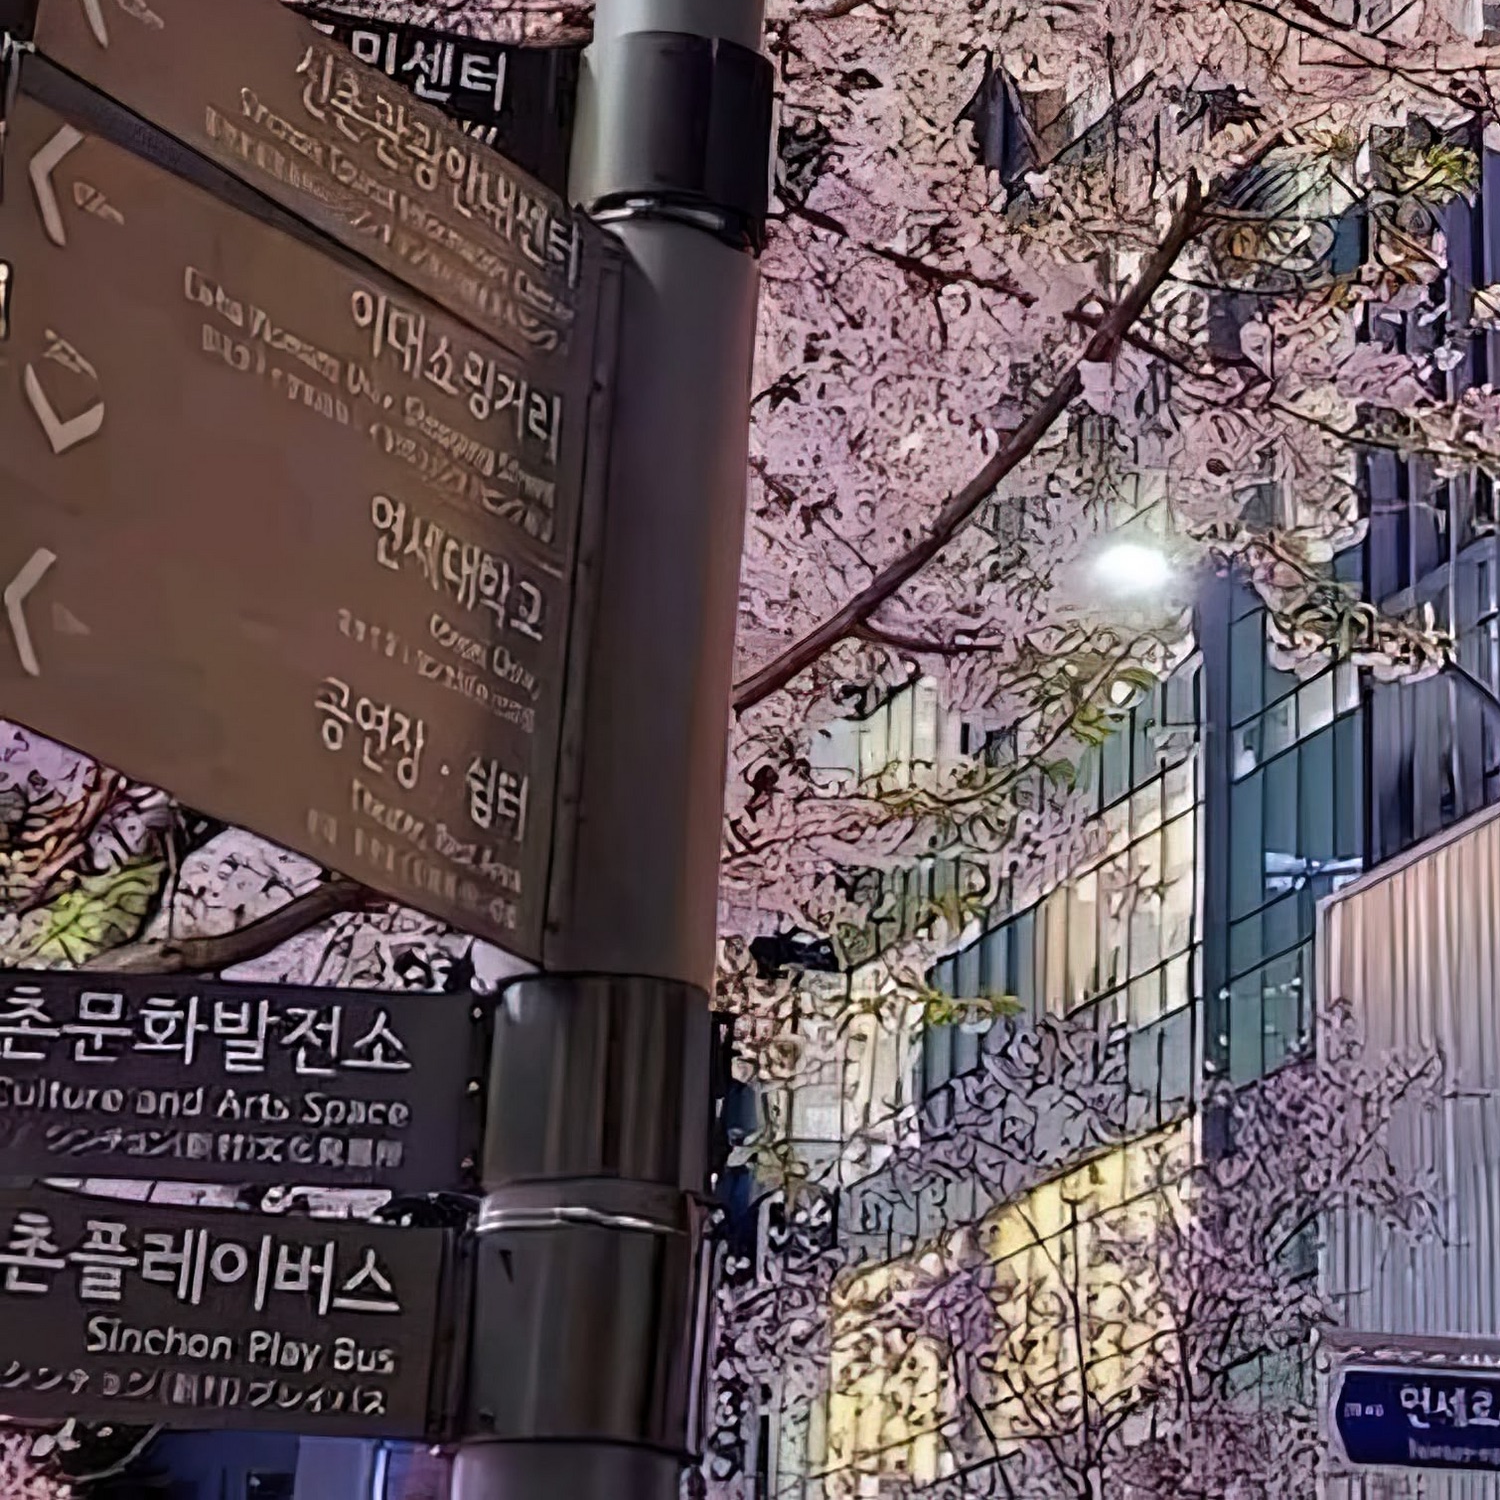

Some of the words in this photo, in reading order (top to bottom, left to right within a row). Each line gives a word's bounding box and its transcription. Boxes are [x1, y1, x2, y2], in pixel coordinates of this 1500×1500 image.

[372, 496, 543, 642] 연세대학교
[313, 676, 425, 790] 공연장
[135, 1086, 204, 1118] and
[216, 1087, 291, 1122] Arts
[301, 1091, 410, 1128] Space
[0, 1212, 401, 1316] 촌플레이버스
[86, 1315, 233, 1361] Sinchon
[247, 1329, 322, 1374] Play
[332, 1336, 396, 1375] Bus
